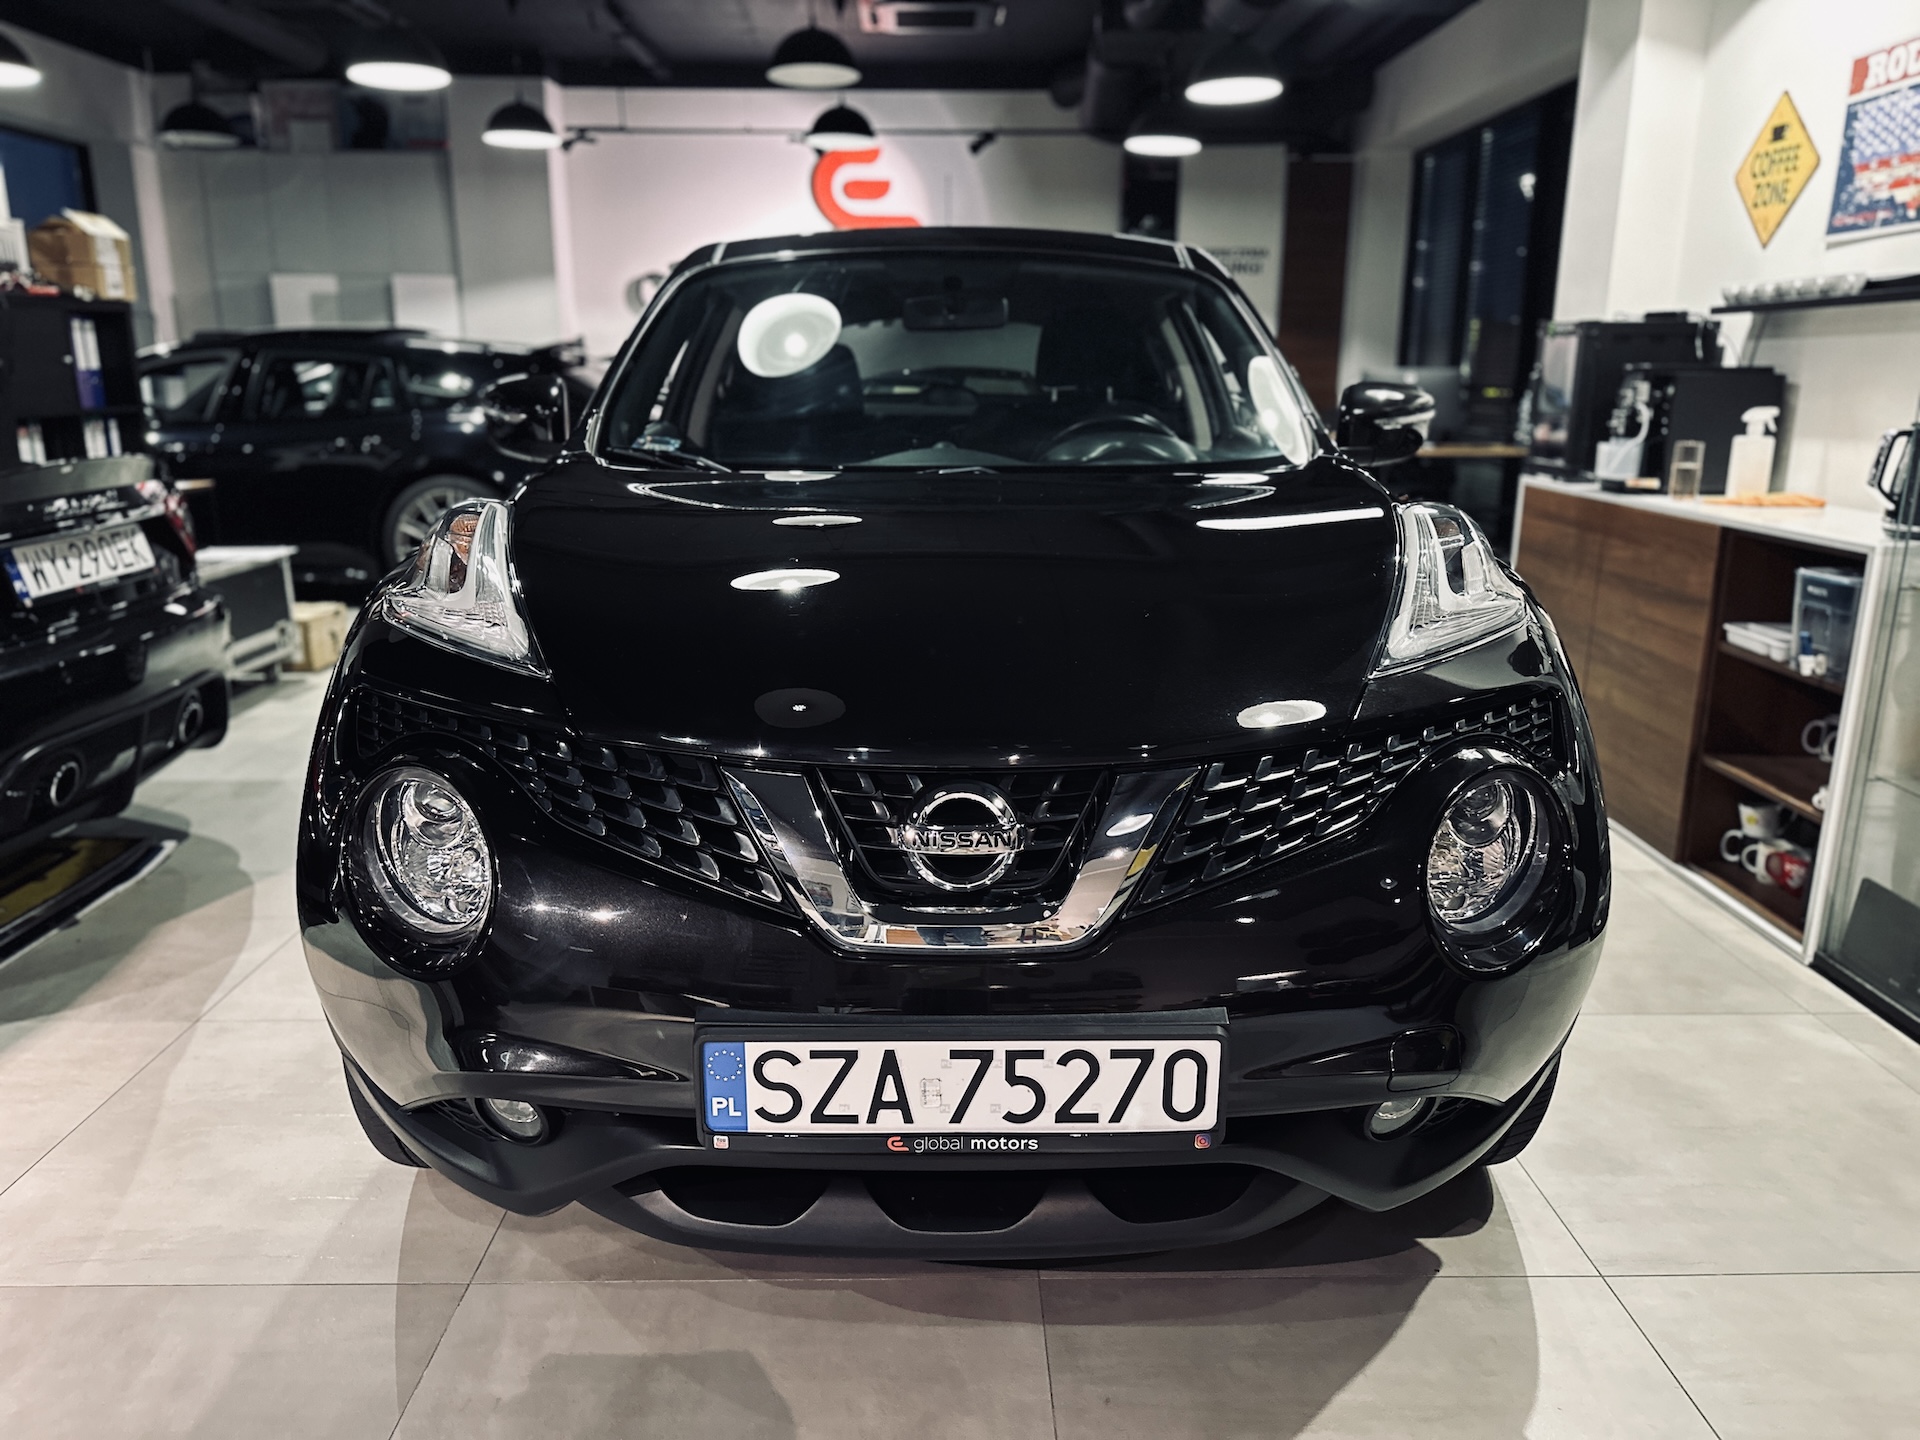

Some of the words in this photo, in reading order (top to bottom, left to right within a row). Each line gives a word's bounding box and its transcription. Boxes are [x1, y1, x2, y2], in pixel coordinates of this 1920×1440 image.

[1751, 143, 1801, 179] COFFEE
[1752, 178, 1790, 209] ZONE
[22, 544, 65, 591] WY
[68, 527, 148, 580] 290EK
[912, 831, 1015, 849] NISSAN
[752, 1049, 914, 1124] SZA
[948, 1048, 1208, 1125] 75270
[711, 1097, 742, 1118] PL
[913, 1136, 964, 1153] global
[970, 1137, 1039, 1151] motors
